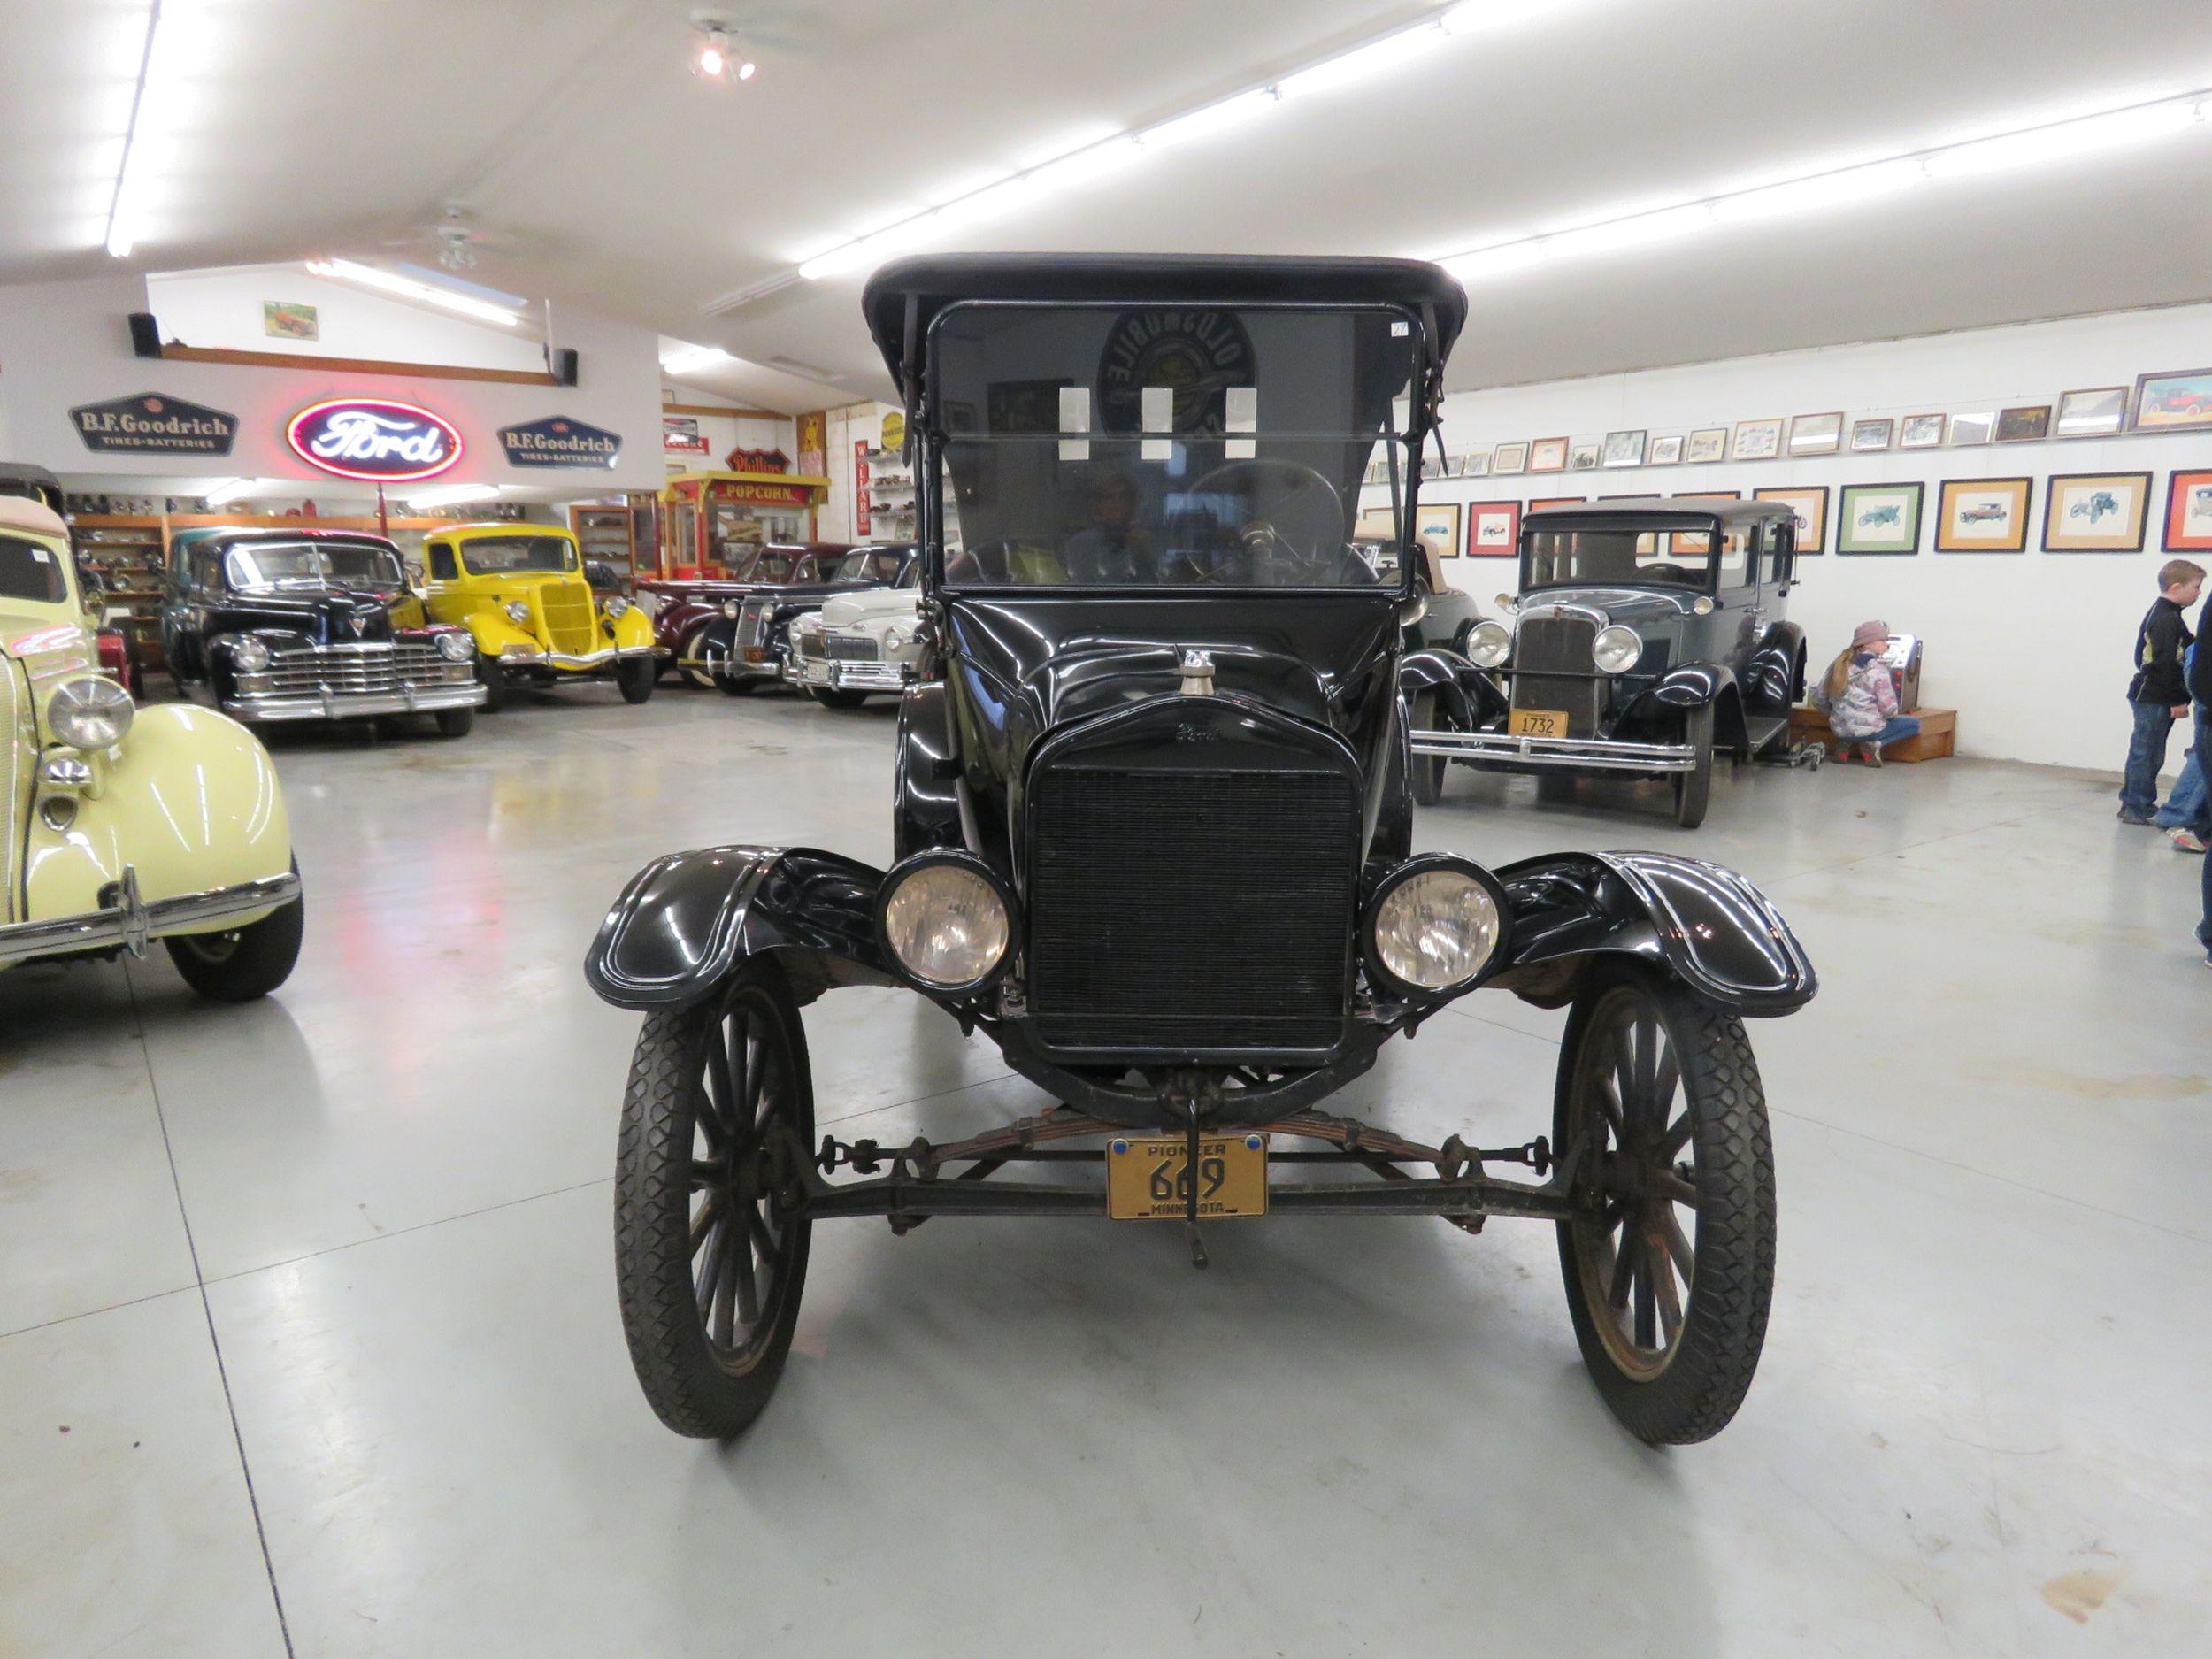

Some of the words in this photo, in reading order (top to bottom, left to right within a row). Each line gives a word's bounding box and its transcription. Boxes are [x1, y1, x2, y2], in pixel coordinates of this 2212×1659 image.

[311, 411, 443, 463] Ford
[726, 484, 791, 500] POPCORN
[1522, 718, 1555, 733] 1732
